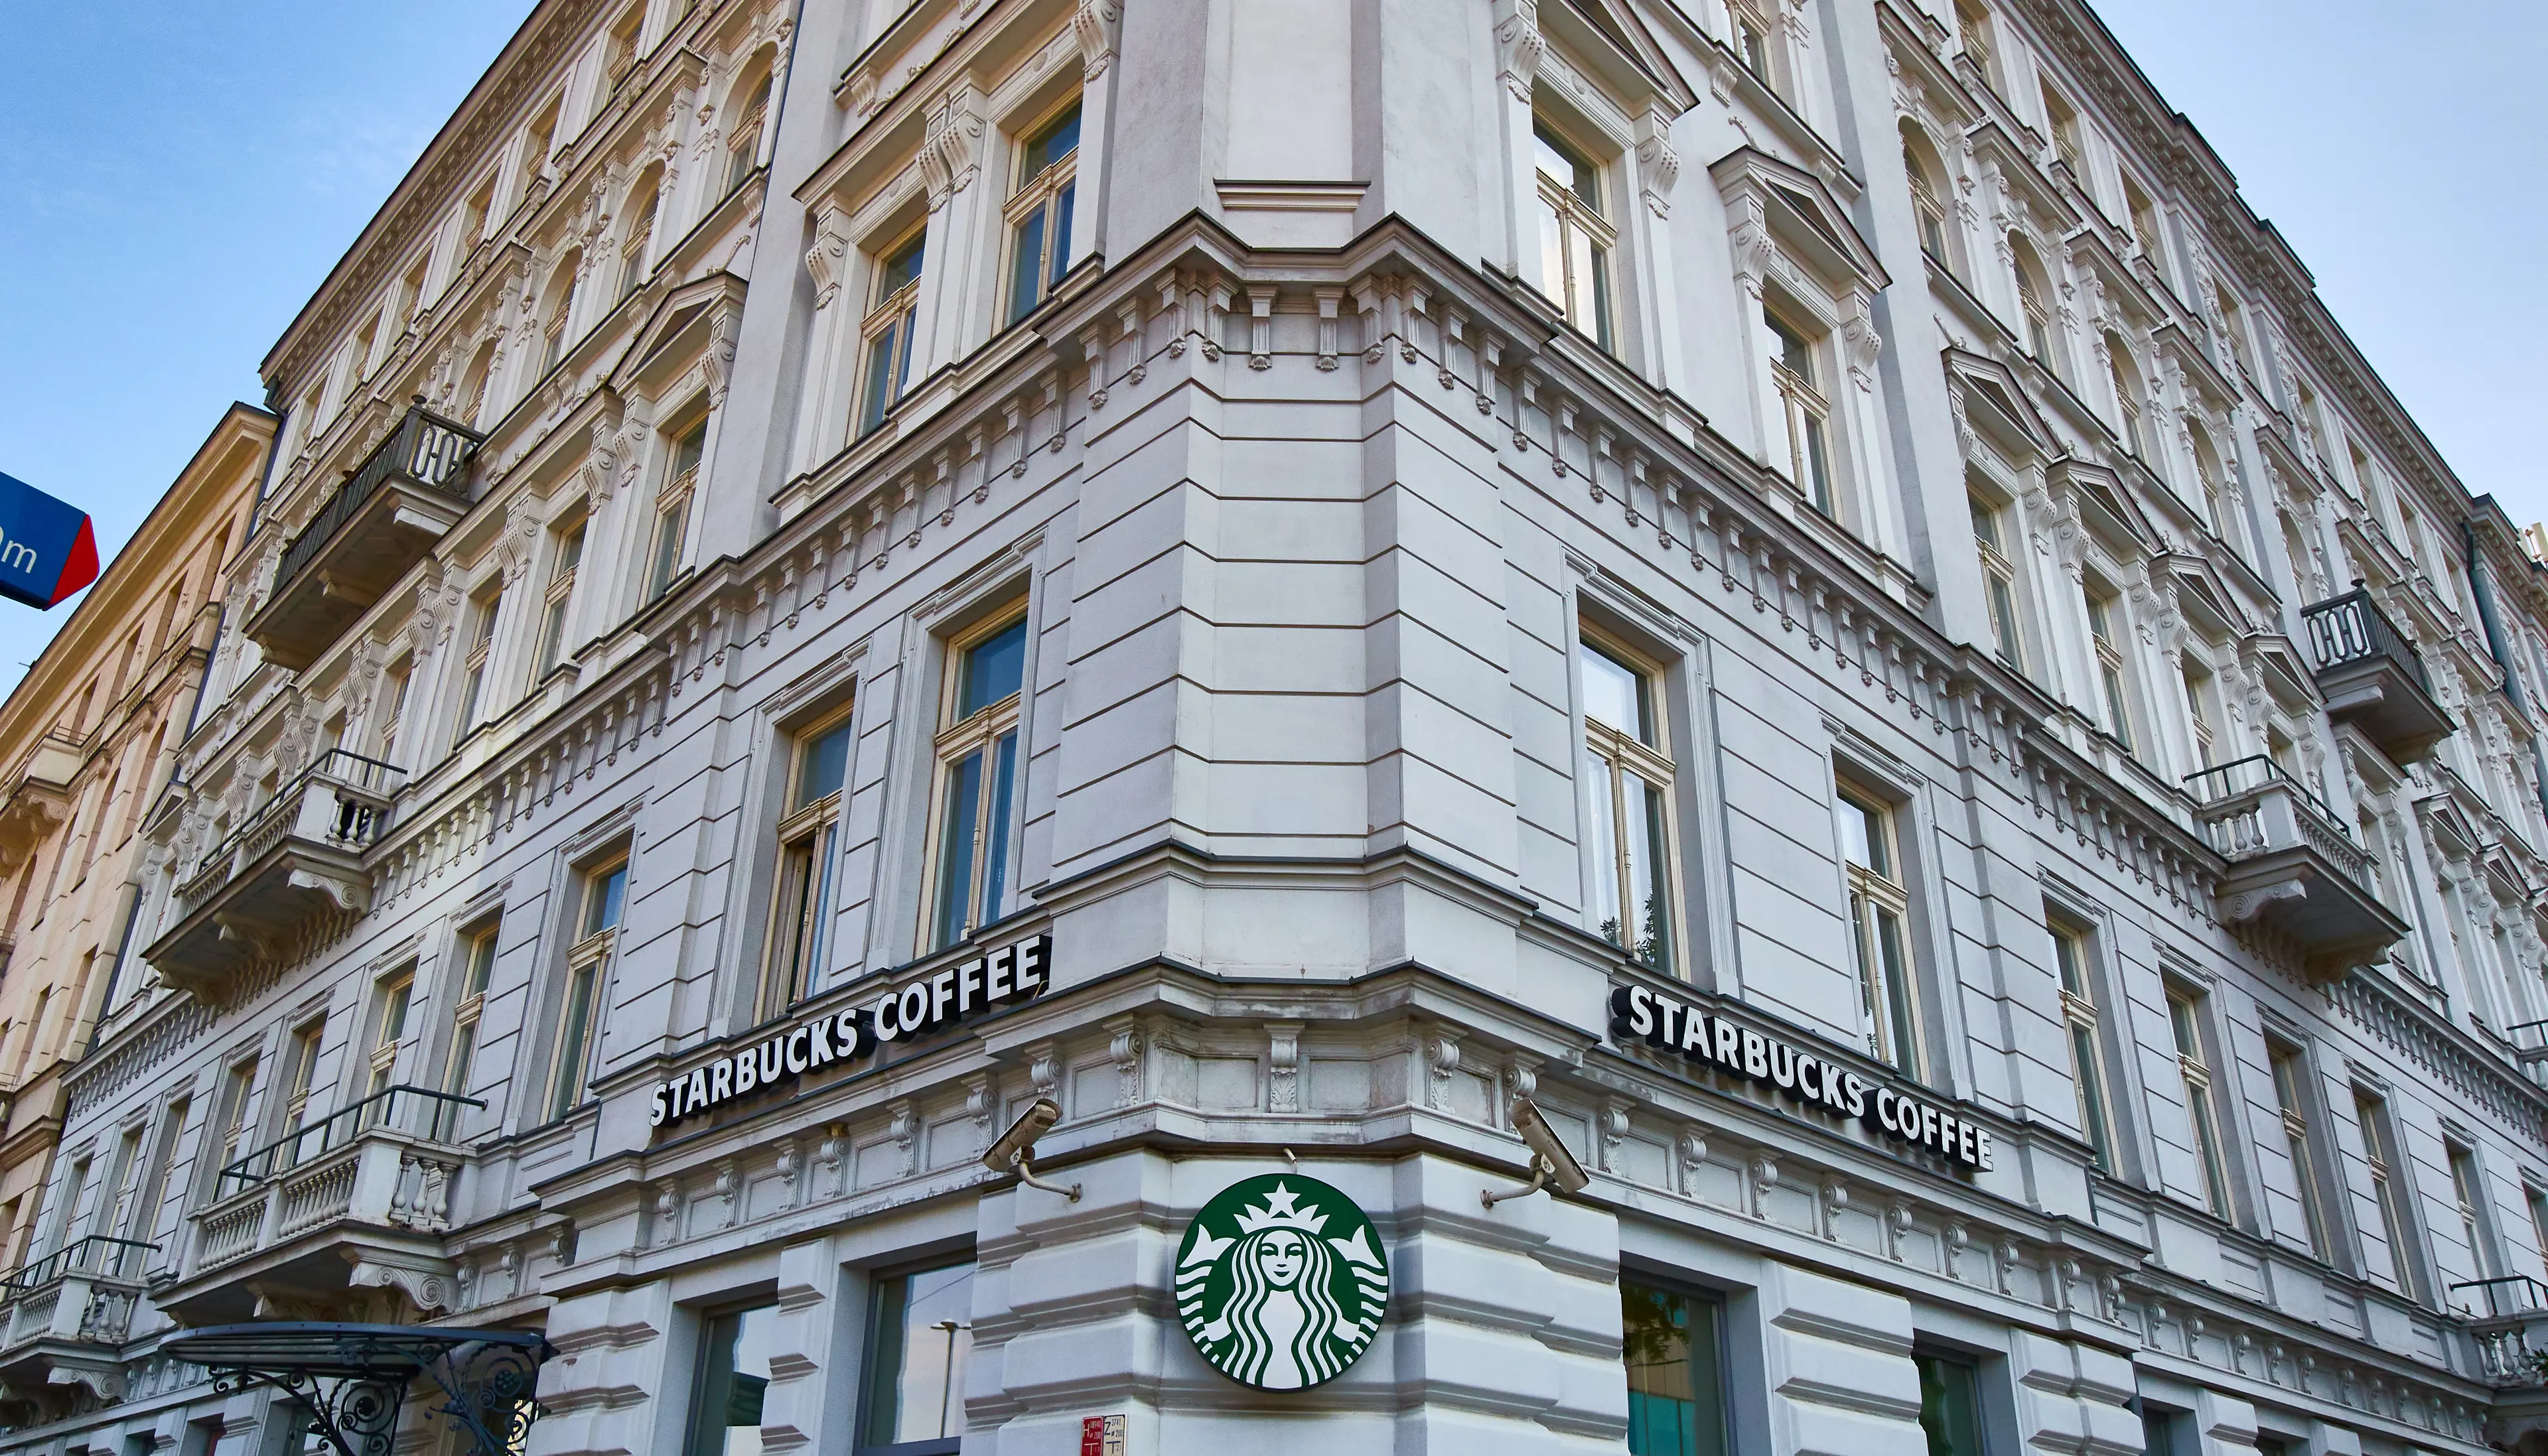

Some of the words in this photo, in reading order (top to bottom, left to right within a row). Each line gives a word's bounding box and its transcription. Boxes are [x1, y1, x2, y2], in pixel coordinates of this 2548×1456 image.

[0, 526, 36, 573] m
[650, 1009, 857, 1126] STARBUCKS
[875, 935, 1040, 1041] COFFEE
[1630, 985, 1864, 1116] STARBUCKS
[1877, 1088, 1993, 1171] COFFEE
